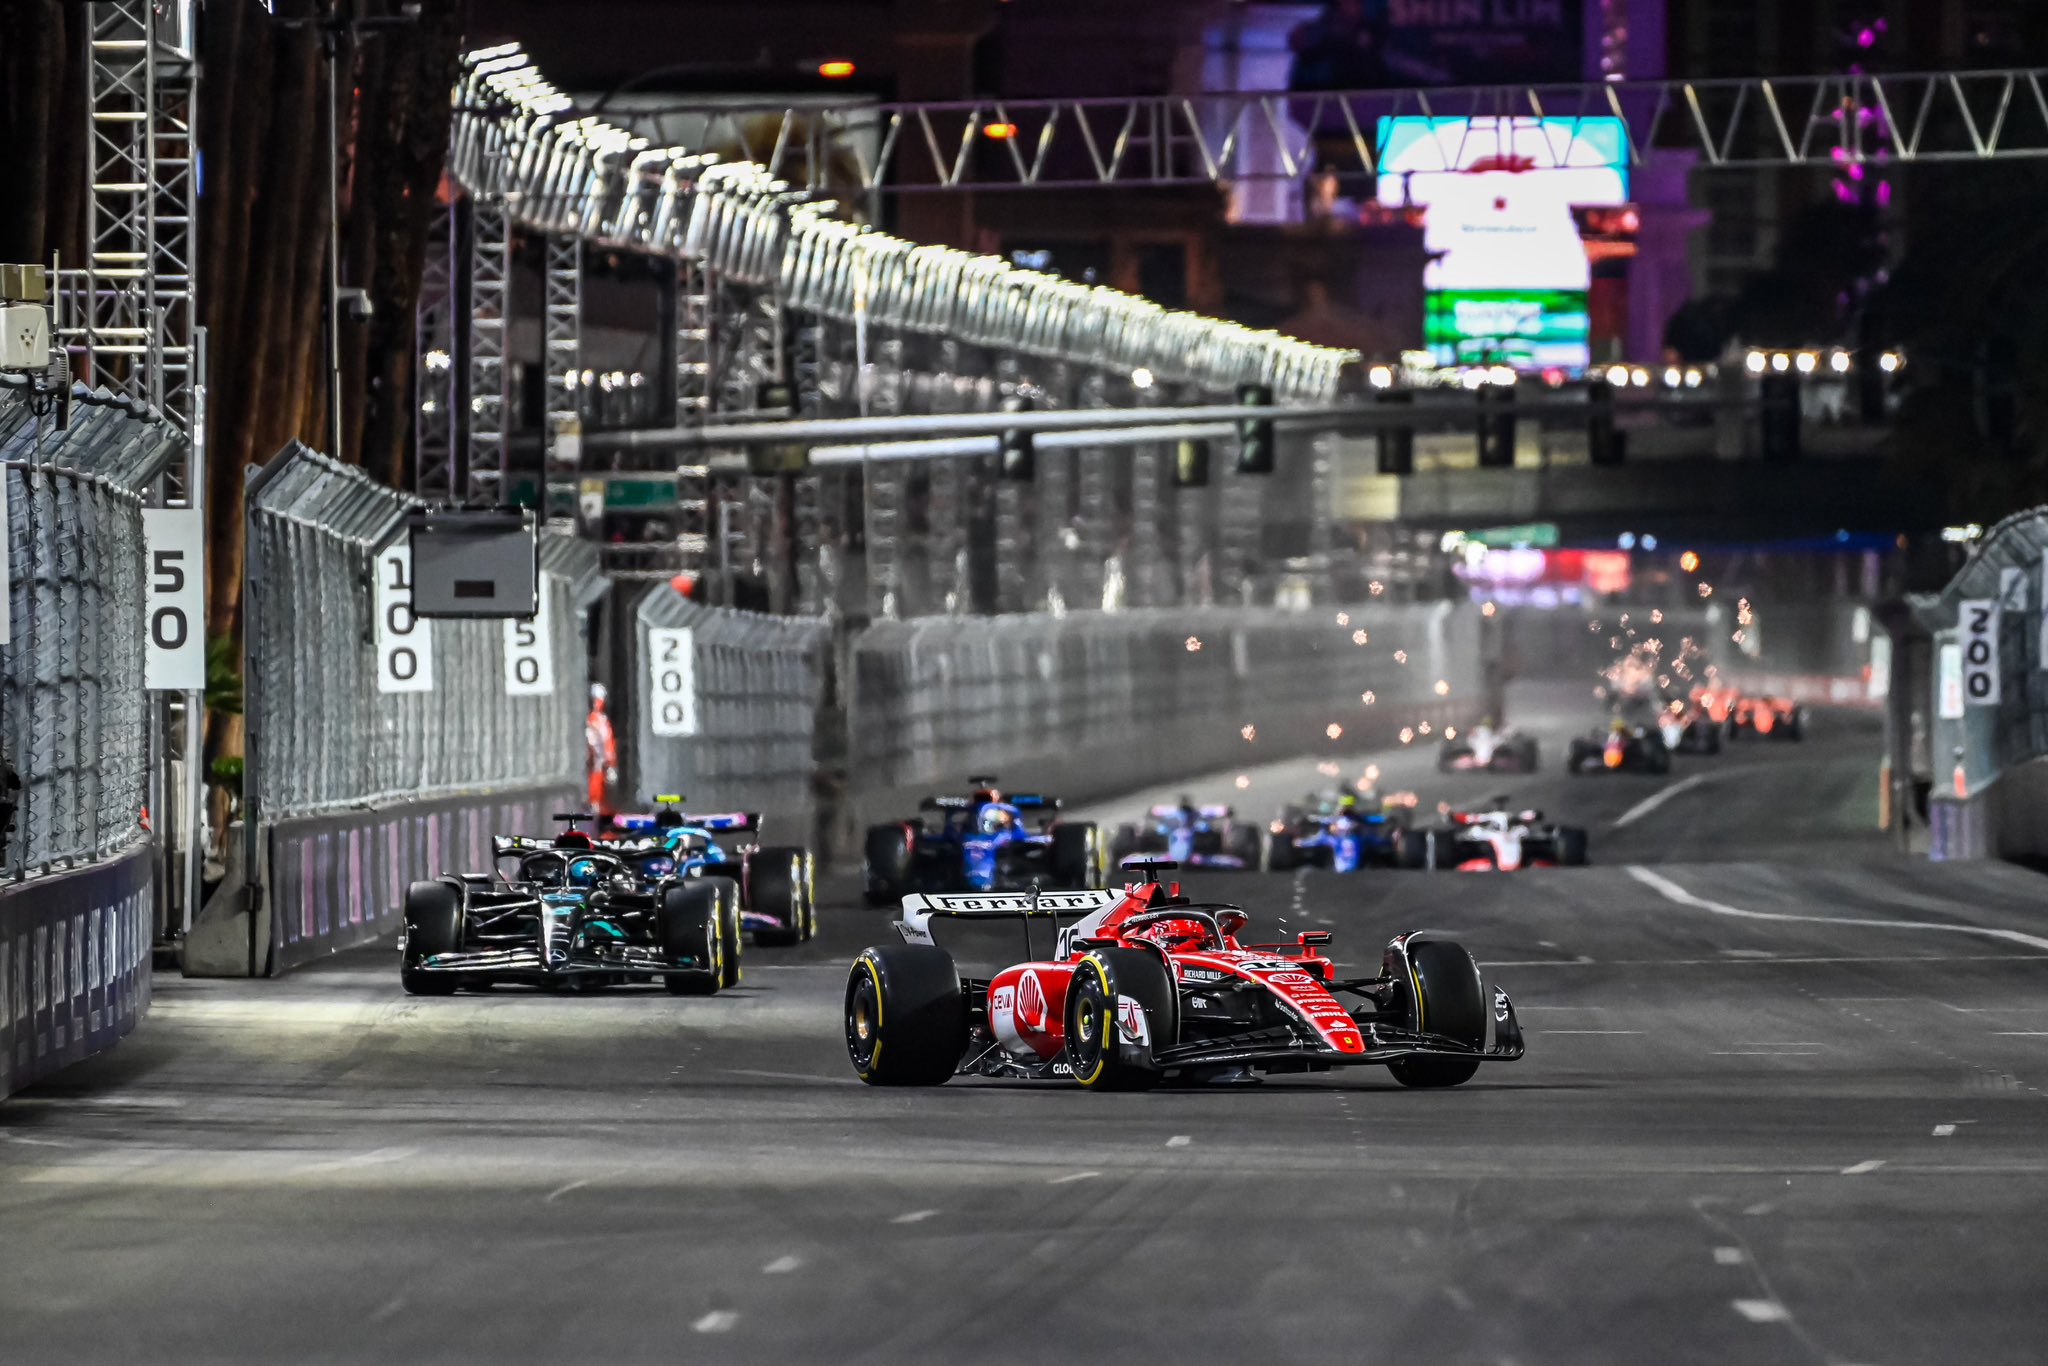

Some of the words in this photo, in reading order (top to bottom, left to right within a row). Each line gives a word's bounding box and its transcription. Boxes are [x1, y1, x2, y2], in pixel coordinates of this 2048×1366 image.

[150, 549, 189, 651] 50
[385, 555, 418, 681] 100
[513, 619, 541, 685] 50
[660, 636, 684, 724] 200
[1966, 607, 1991, 699] 200
[937, 892, 1104, 911] Ferrari
[994, 994, 1013, 1010] CEVA
[1183, 969, 1206, 979] RICHARD
[1206, 970, 1222, 980] MILLE
